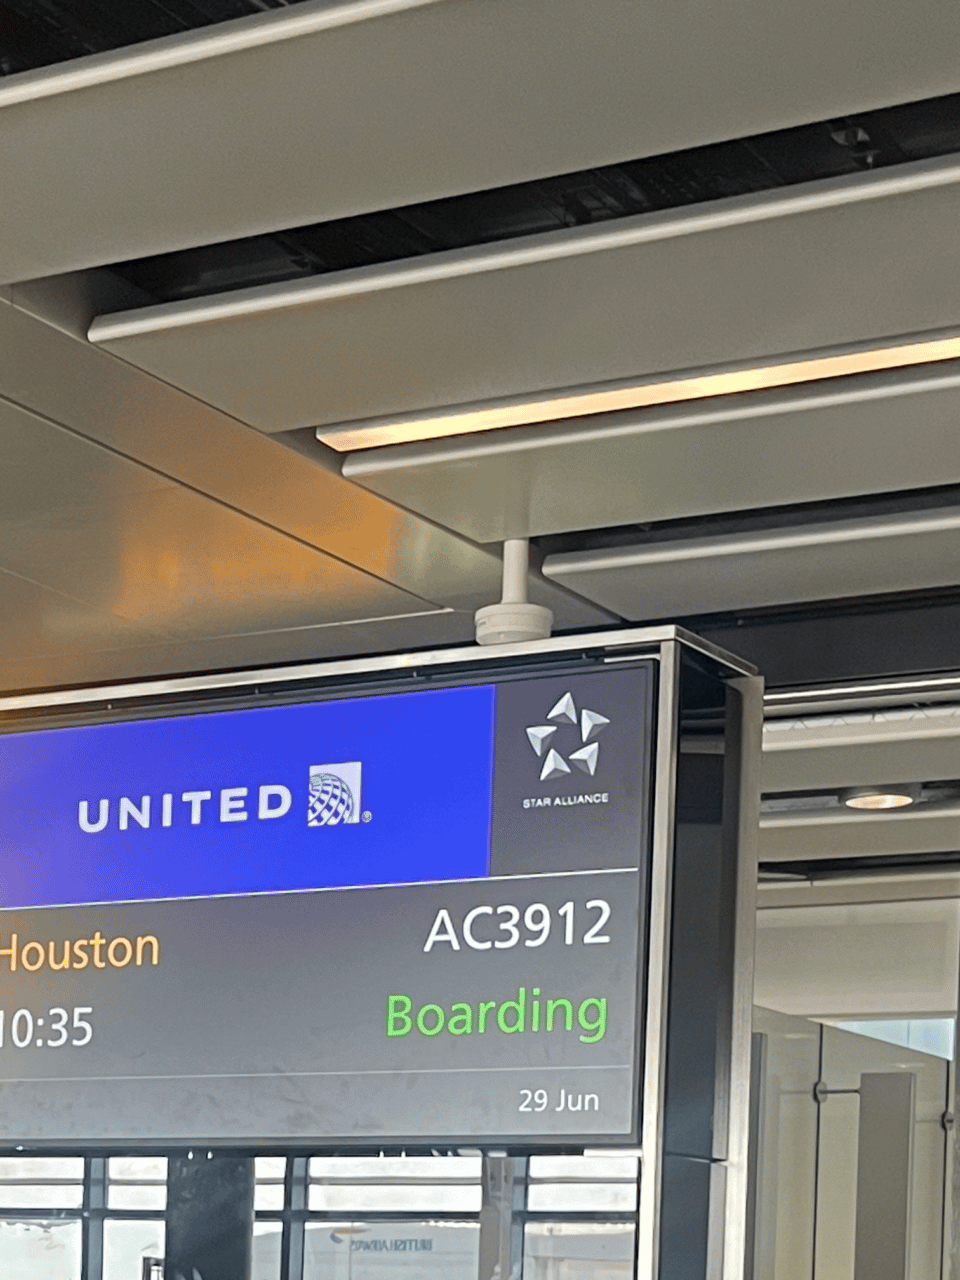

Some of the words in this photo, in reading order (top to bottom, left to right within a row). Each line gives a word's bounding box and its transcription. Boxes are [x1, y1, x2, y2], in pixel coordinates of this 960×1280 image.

[77, 783, 293, 833] UNITED
[522, 797, 551, 809] STAR
[553, 792, 609, 806] ALLIANCE
[423, 899, 612, 953] AC3912
[386, 986, 608, 1044] Boarding
[517, 1089, 548, 1112] 29
[554, 1088, 600, 1114] Jun
